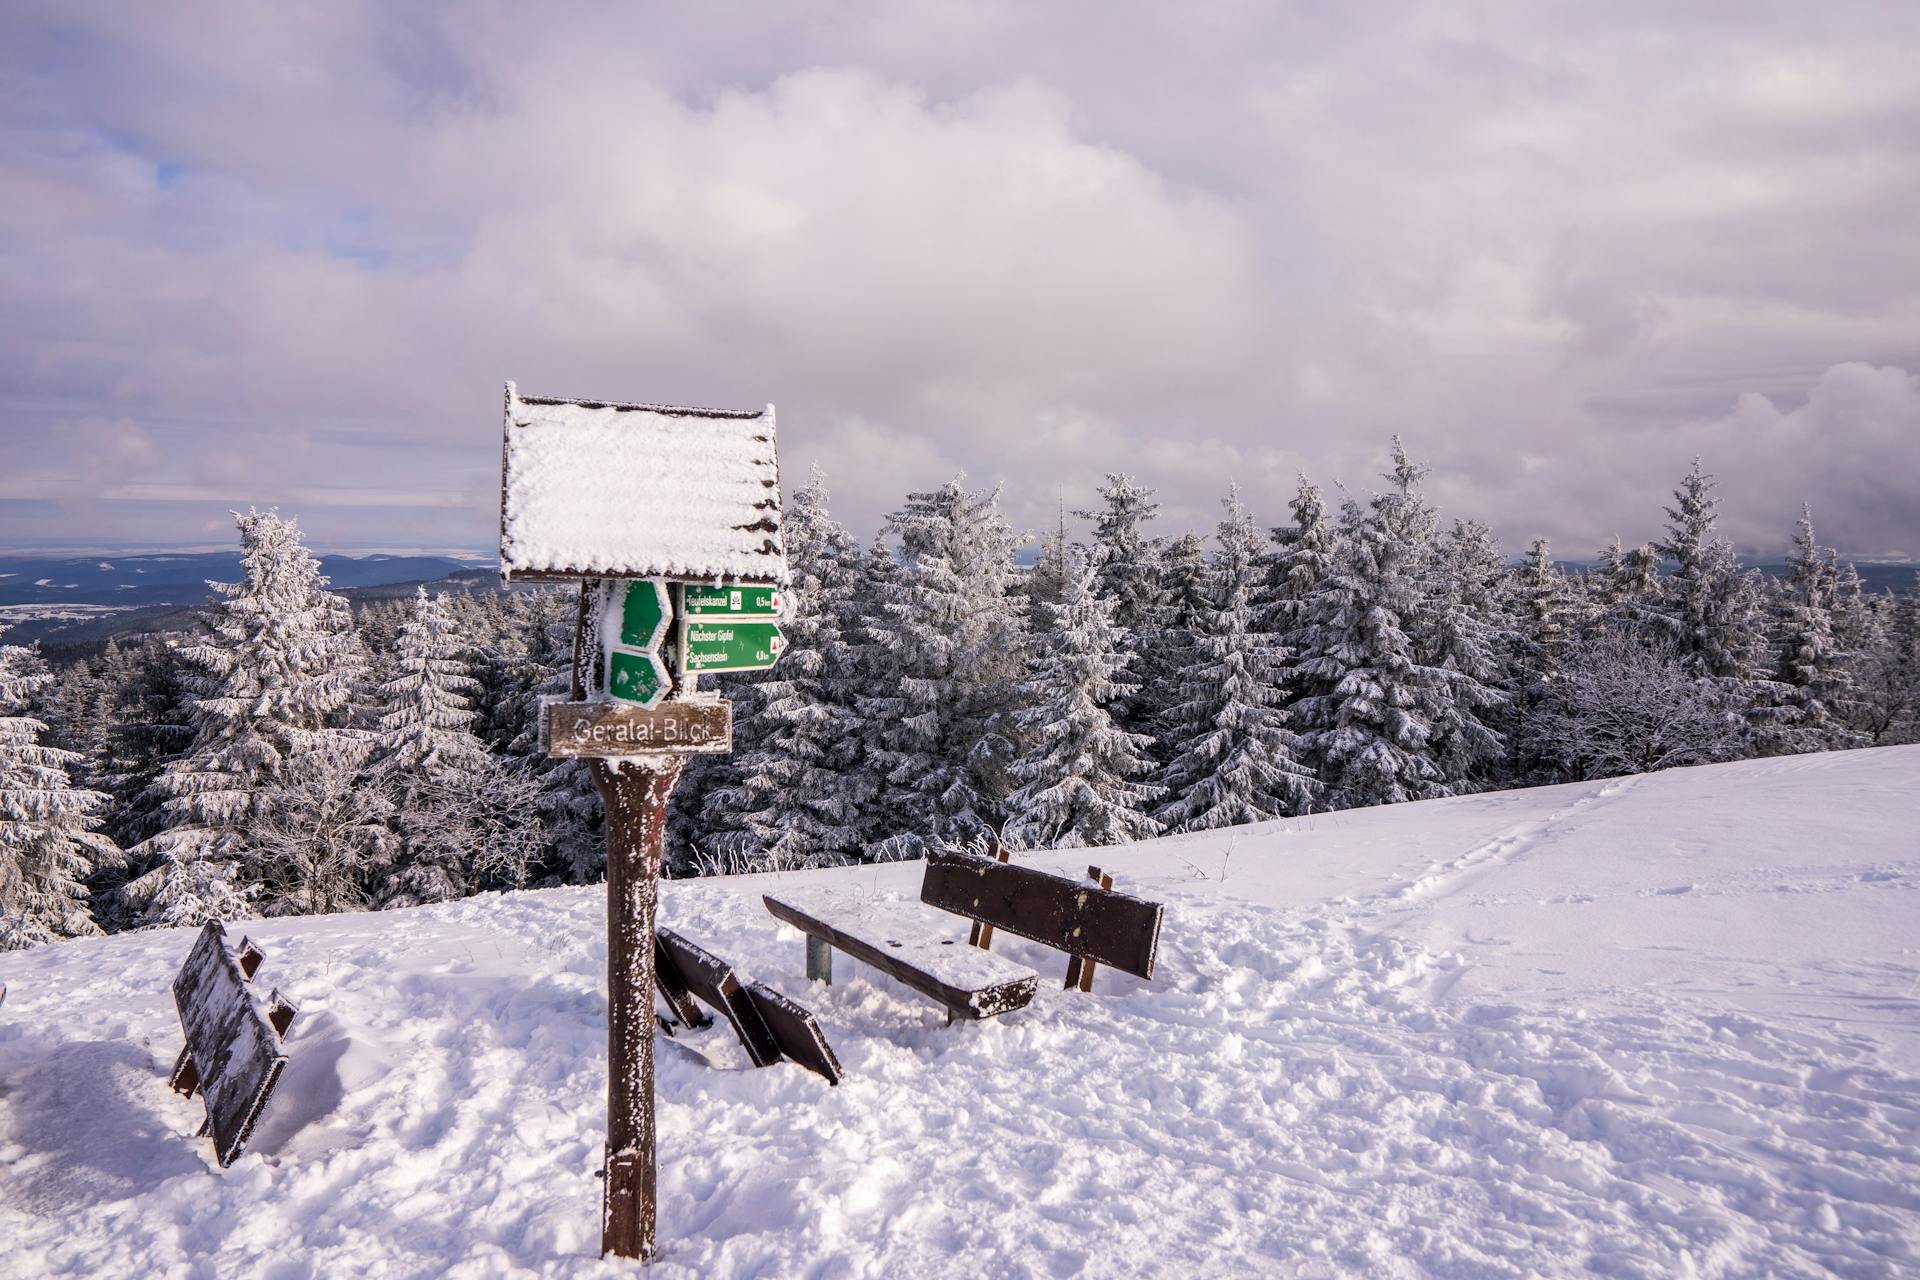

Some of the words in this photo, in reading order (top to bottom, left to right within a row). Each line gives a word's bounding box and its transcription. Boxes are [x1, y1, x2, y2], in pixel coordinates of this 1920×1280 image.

[688, 595, 727, 607] Teufelskanzel
[756, 596, 764, 607] 0,5
[690, 631, 716, 642] Nächster
[718, 630, 733, 642] Gipfel
[689, 652, 728, 663] Sachsenstein
[574, 718, 710, 742] Geratal-Blick
